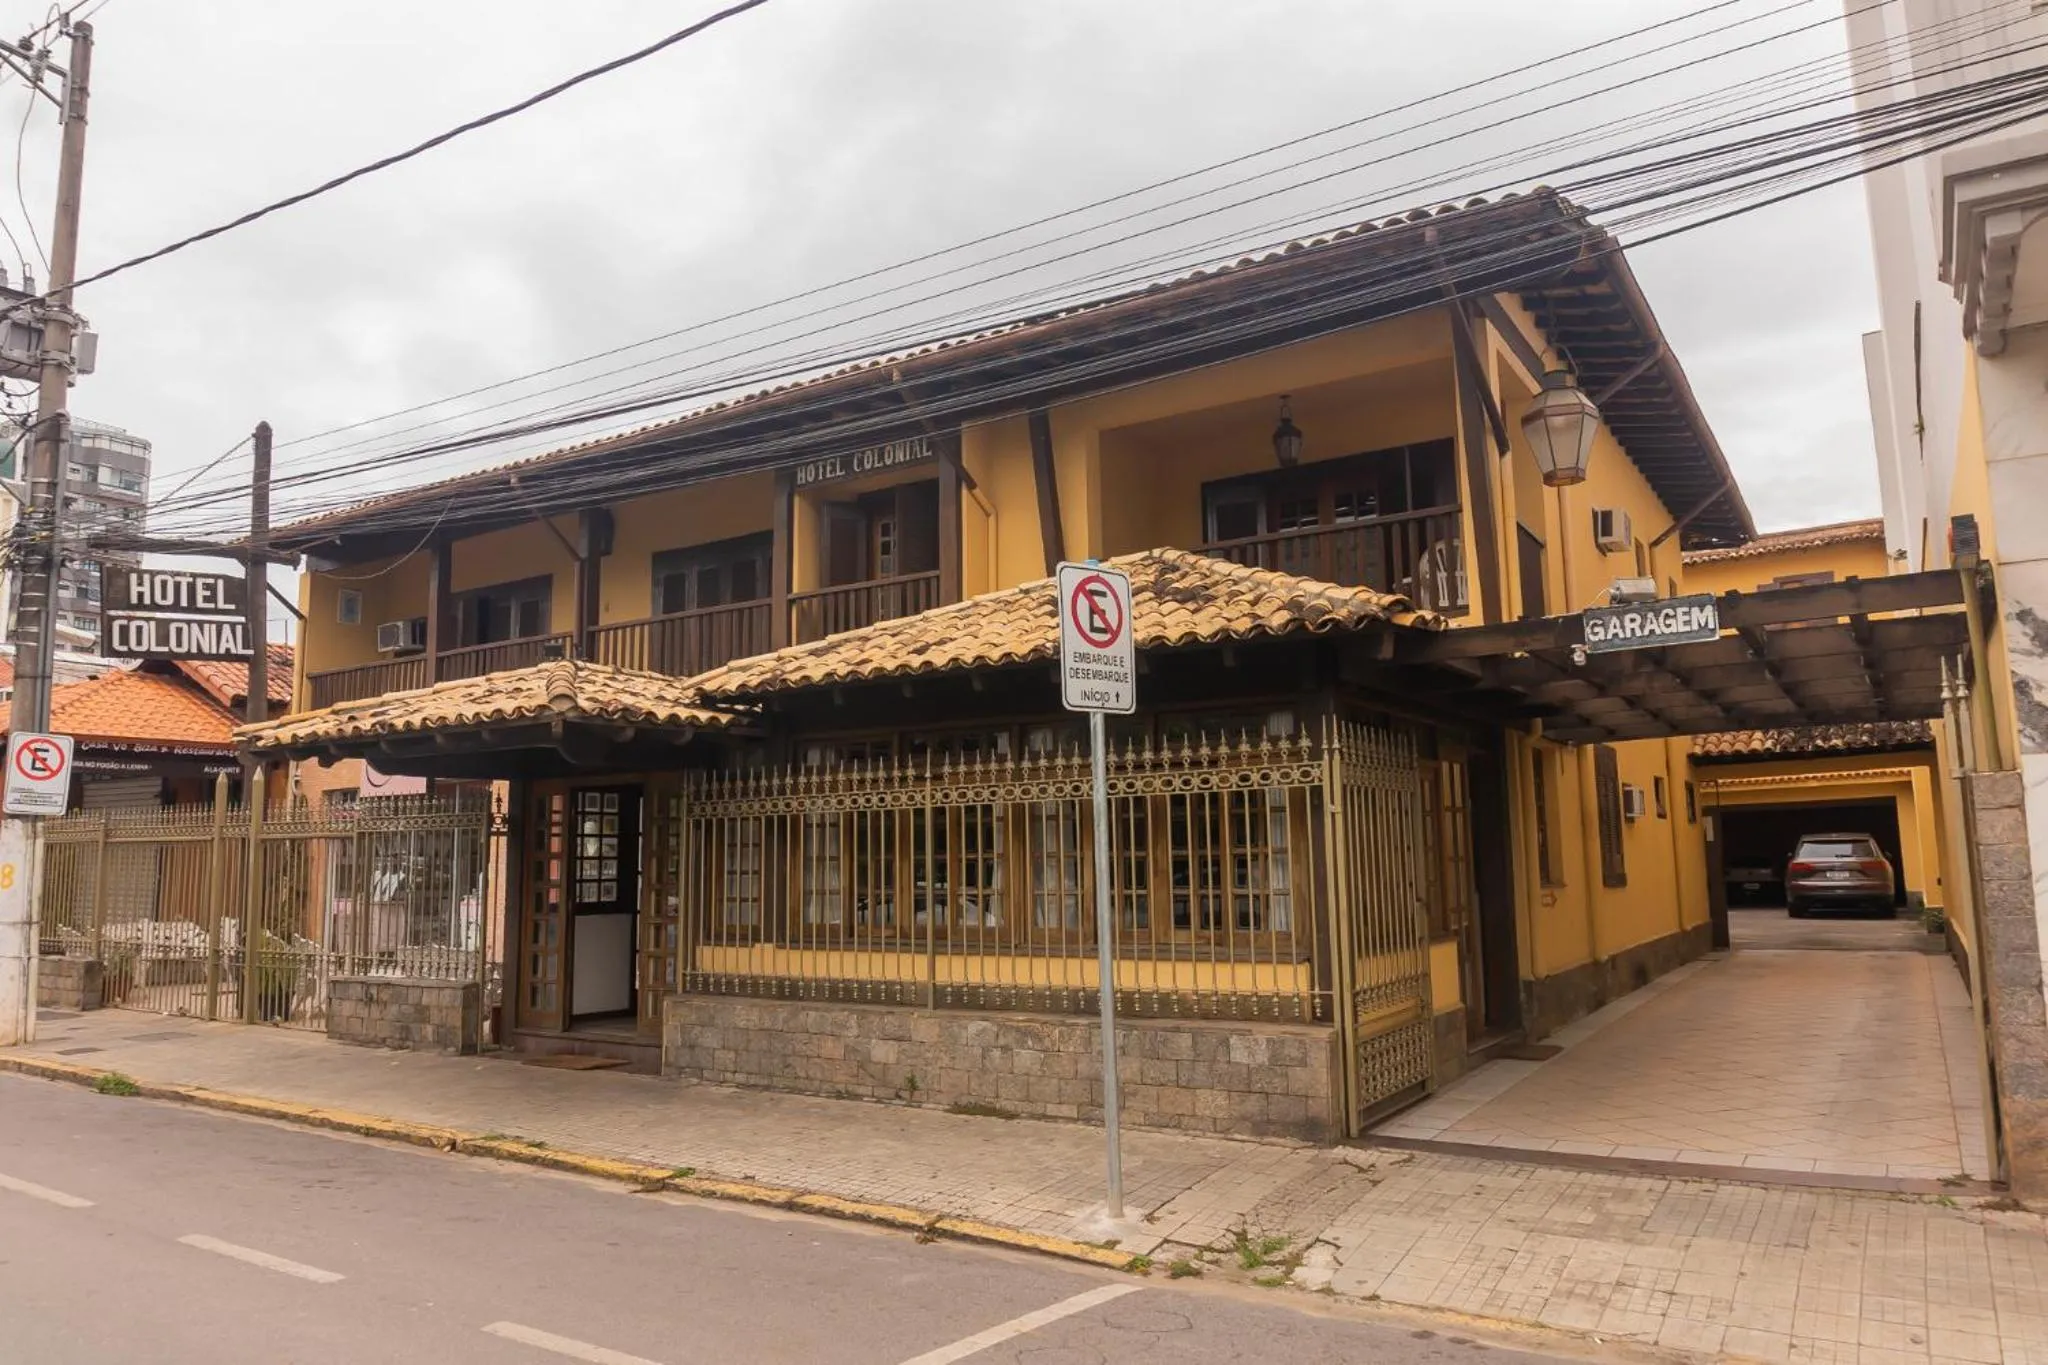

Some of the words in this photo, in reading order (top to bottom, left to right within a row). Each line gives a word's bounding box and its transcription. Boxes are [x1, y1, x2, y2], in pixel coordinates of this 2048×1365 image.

[797, 457, 846, 486] HOTEL
[853, 438, 933, 473] COLONIAL
[129, 572, 236, 610] HOTEL
[1088, 588, 1109, 634] E
[1585, 604, 1716, 643] GARAGEM
[111, 618, 255, 655] COLONIAL
[1069, 667, 1130, 684] DESEMBARQUE
[1073, 651, 1119, 667] EMBARQUE
[1119, 656, 1125, 668] E
[1080, 688, 1111, 703] INÍCIO
[31, 747, 49, 772] E
